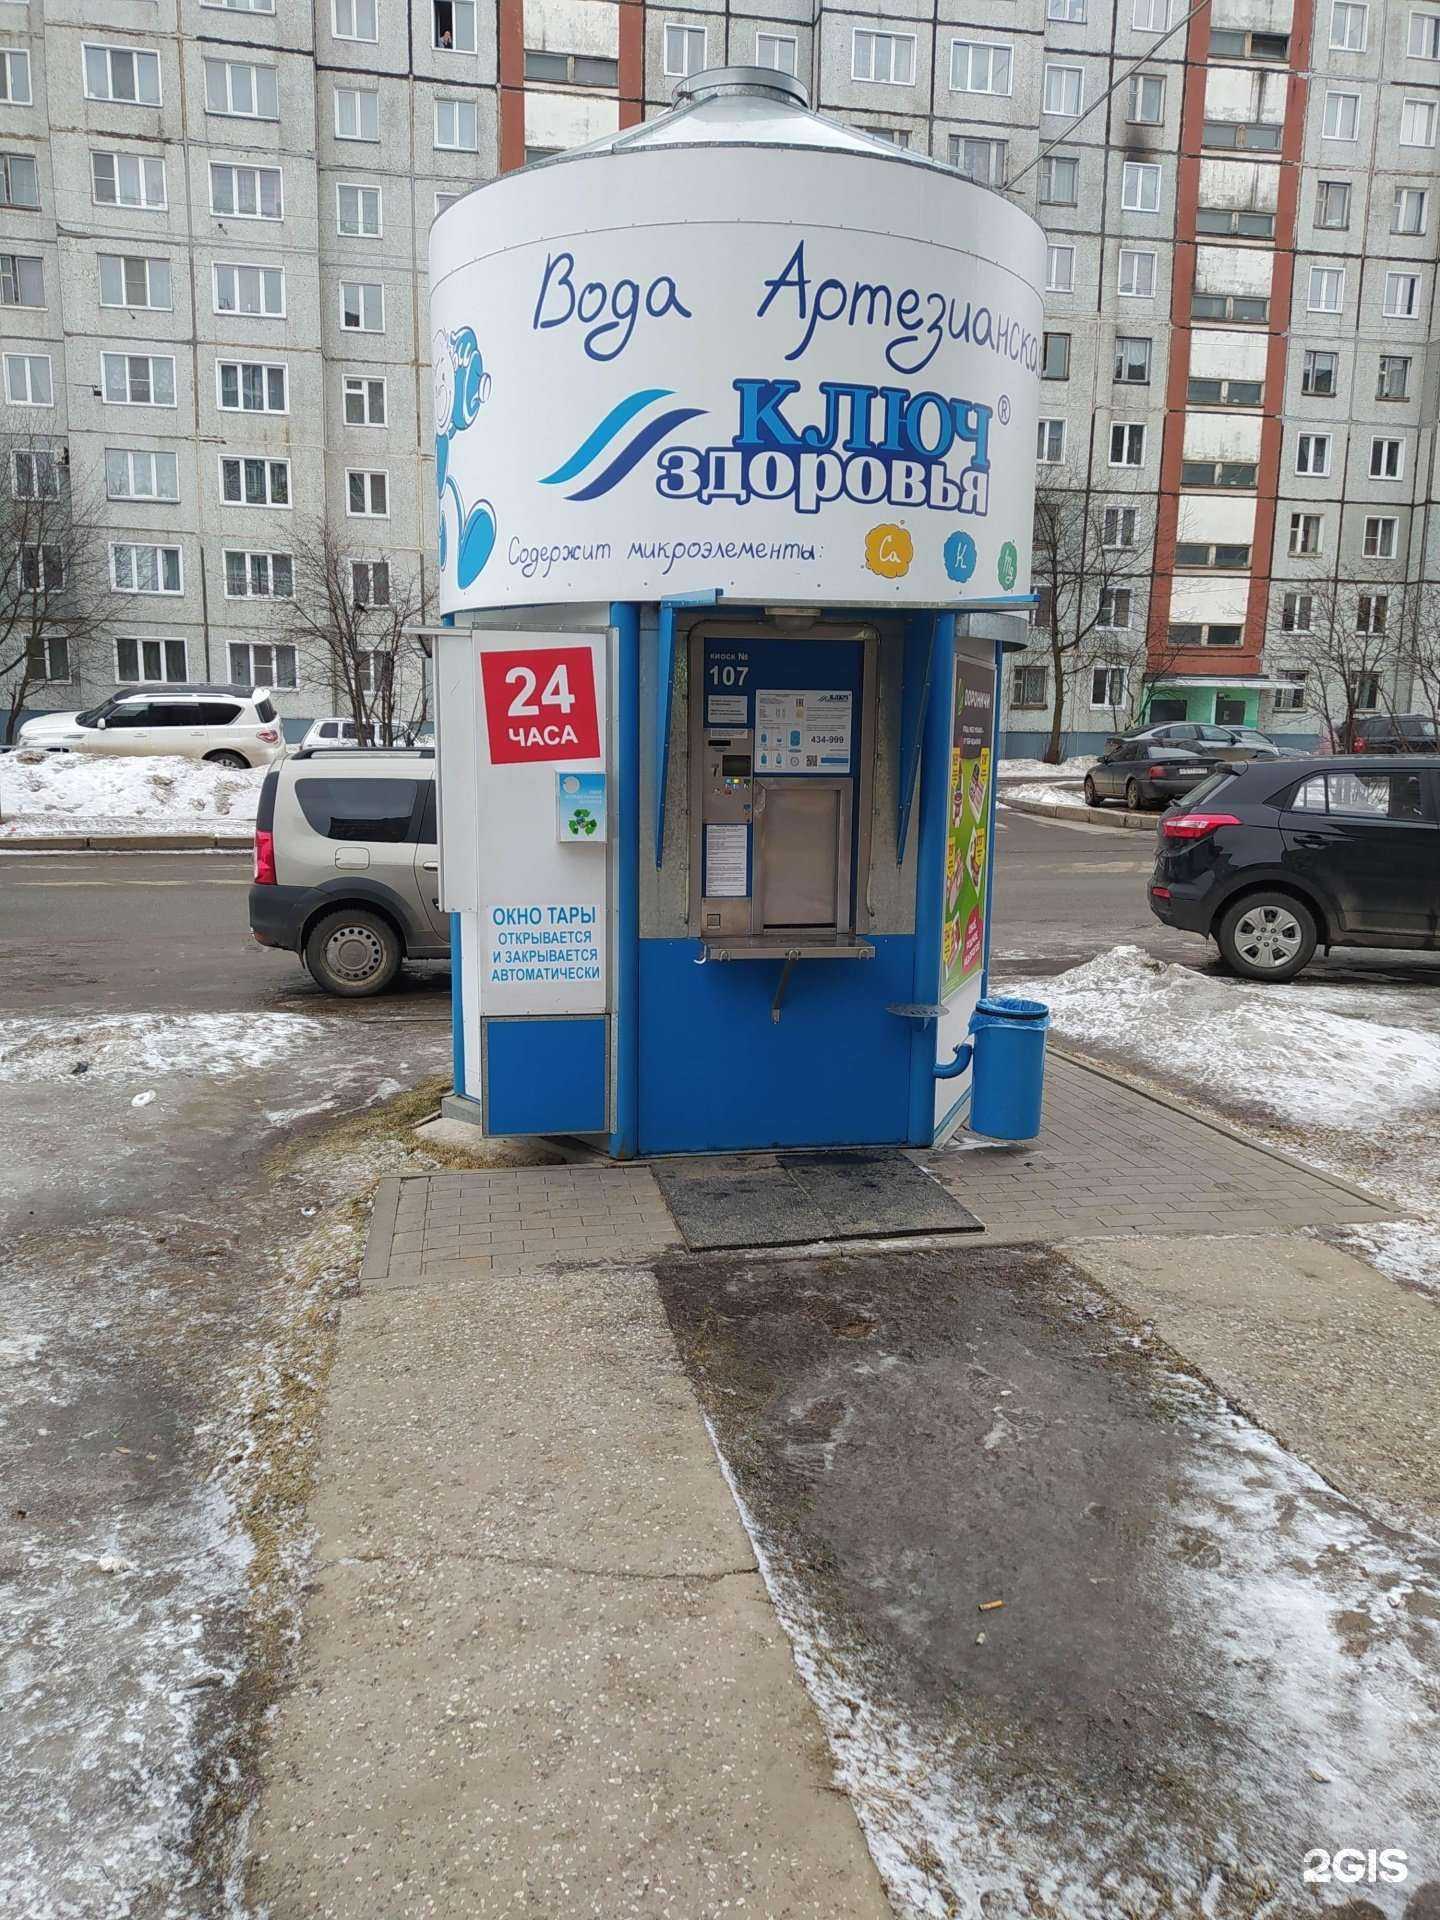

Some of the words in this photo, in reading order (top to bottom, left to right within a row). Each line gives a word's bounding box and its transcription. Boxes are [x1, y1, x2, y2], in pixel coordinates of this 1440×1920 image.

[533, 252, 692, 361] Вода
[757, 239, 1042, 382] Артезианска
[732, 378, 993, 469] КЛЮЧ
[508, 536, 611, 578] Содержит
[627, 540, 824, 575] микроэлементы:
[879, 535, 901, 563] Ca
[709, 665, 749, 686] 107
[505, 664, 575, 716] 24
[508, 724, 579, 747] ЧАСА
[493, 907, 542, 926] ОКНО
[547, 906, 596, 925] ТАРЫ
[498, 930, 592, 946] ОТКРЫВАЕТСЯ
[493, 951, 502, 963] И
[505, 948, 598, 963] ЗАКРЫВАЕТСЯ
[491, 966, 600, 982] АВТОМАТИЧЕСКИ
